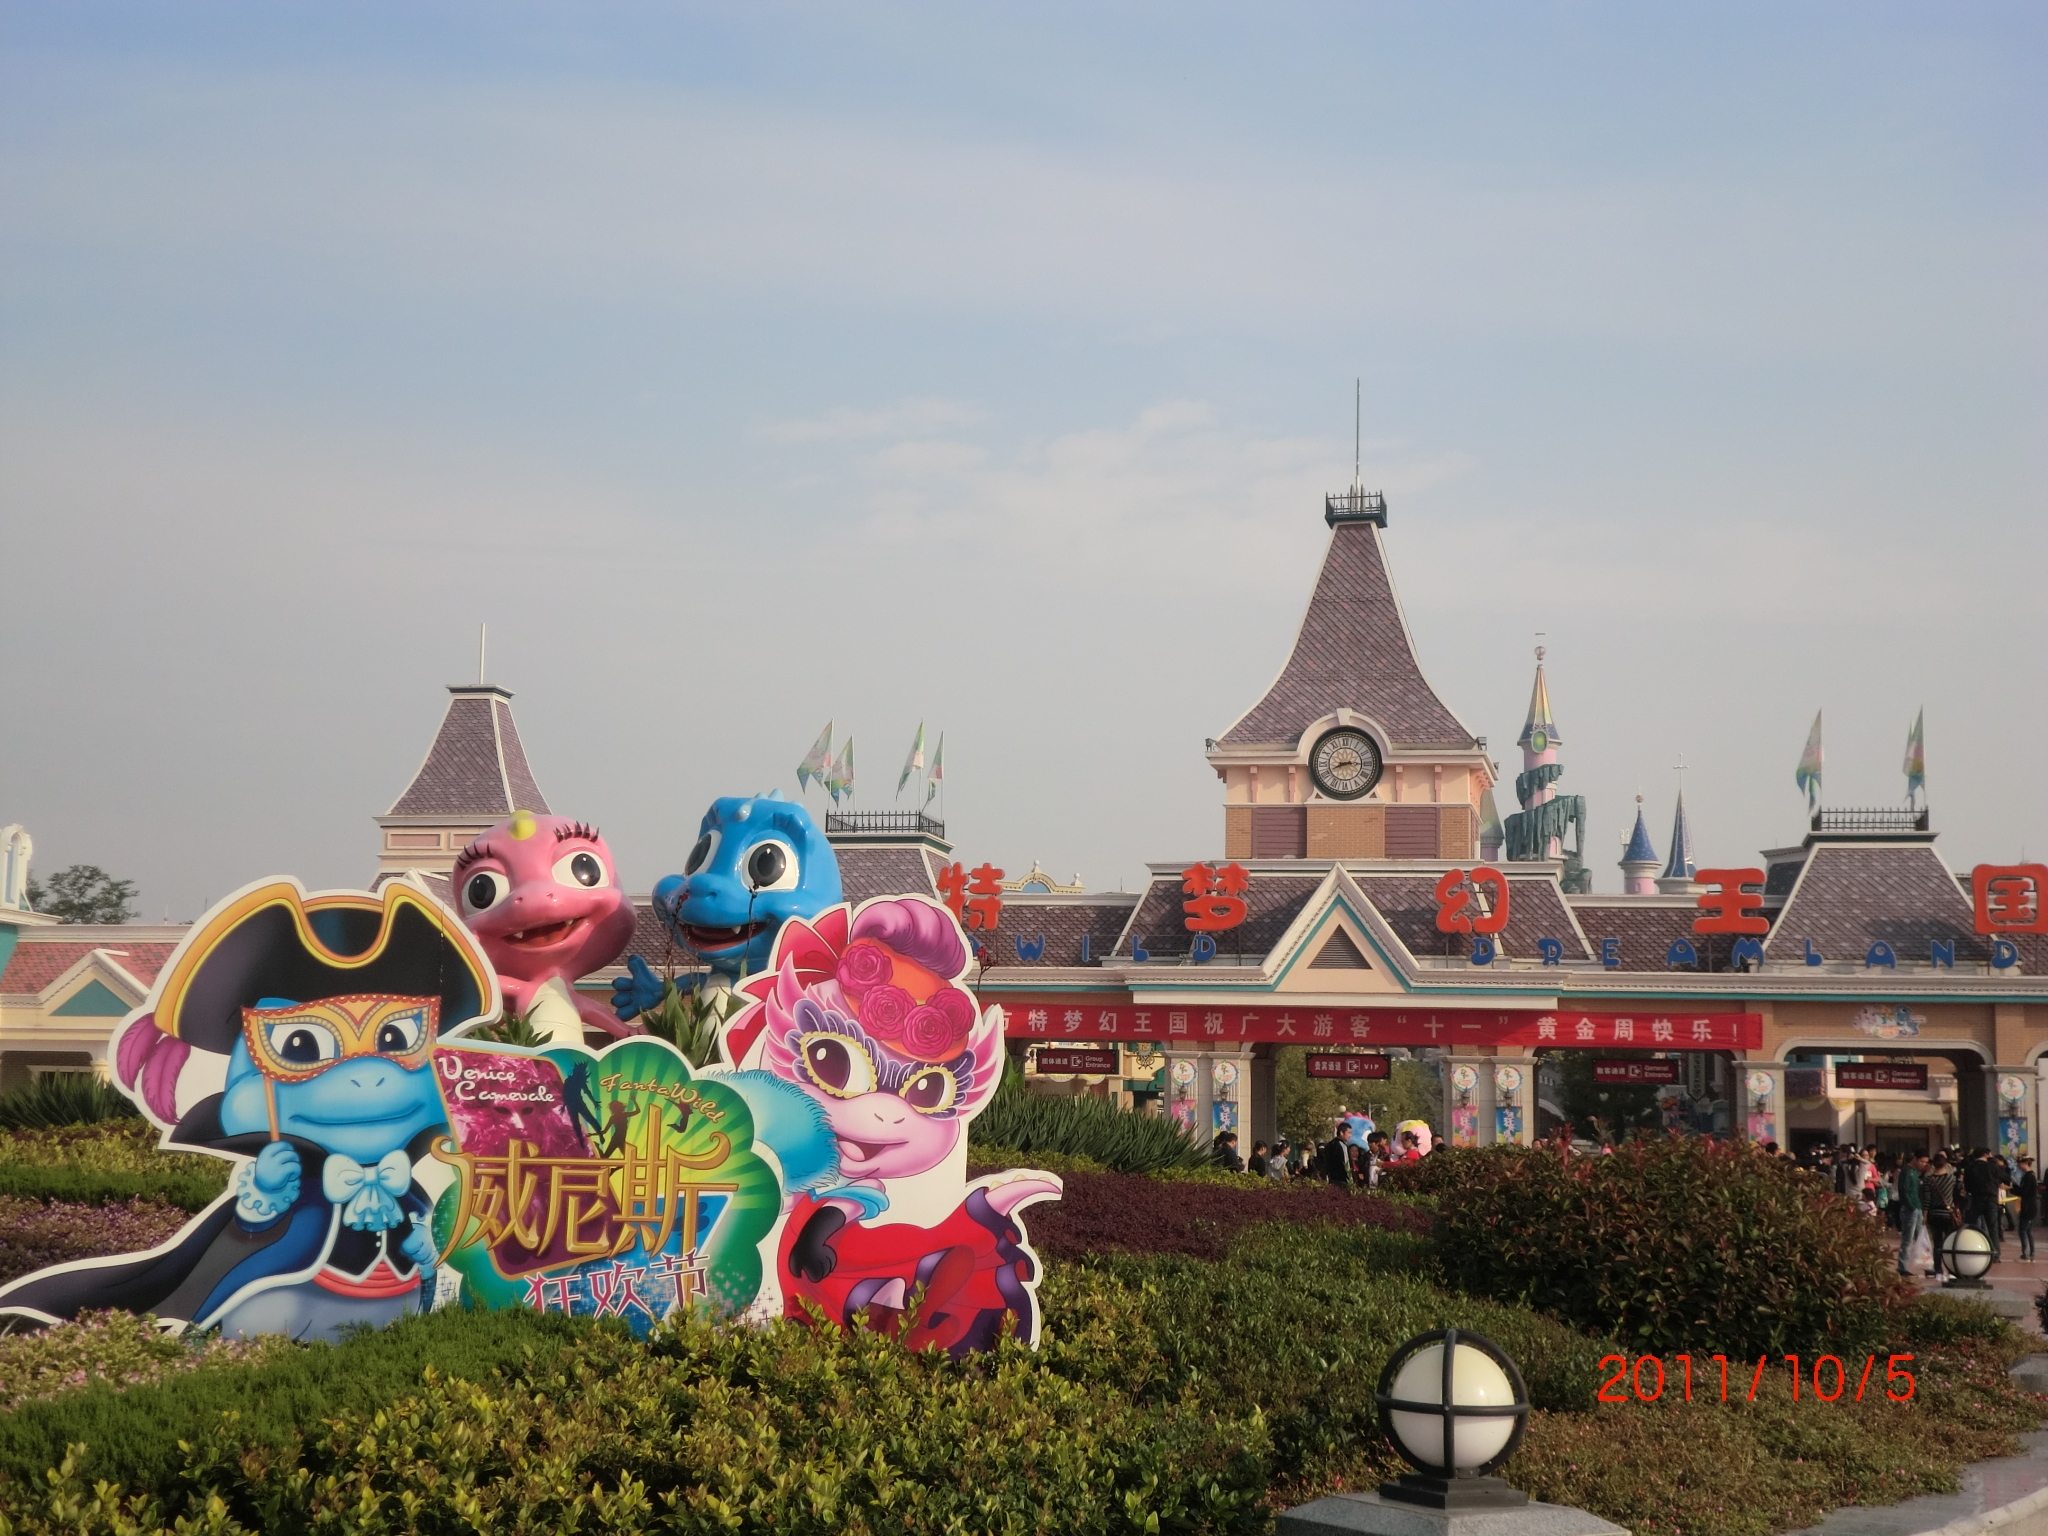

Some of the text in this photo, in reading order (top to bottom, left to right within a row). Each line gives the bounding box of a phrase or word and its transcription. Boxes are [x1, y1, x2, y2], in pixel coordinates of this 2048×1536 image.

[1471, 937, 2019, 969] DREAMLAND
[438, 1055, 517, 1082] Venice
[599, 1073, 726, 1123] FantaWild
[430, 1103, 739, 1307] 威尼斯
[523, 1247, 711, 1320] 狂欢节
